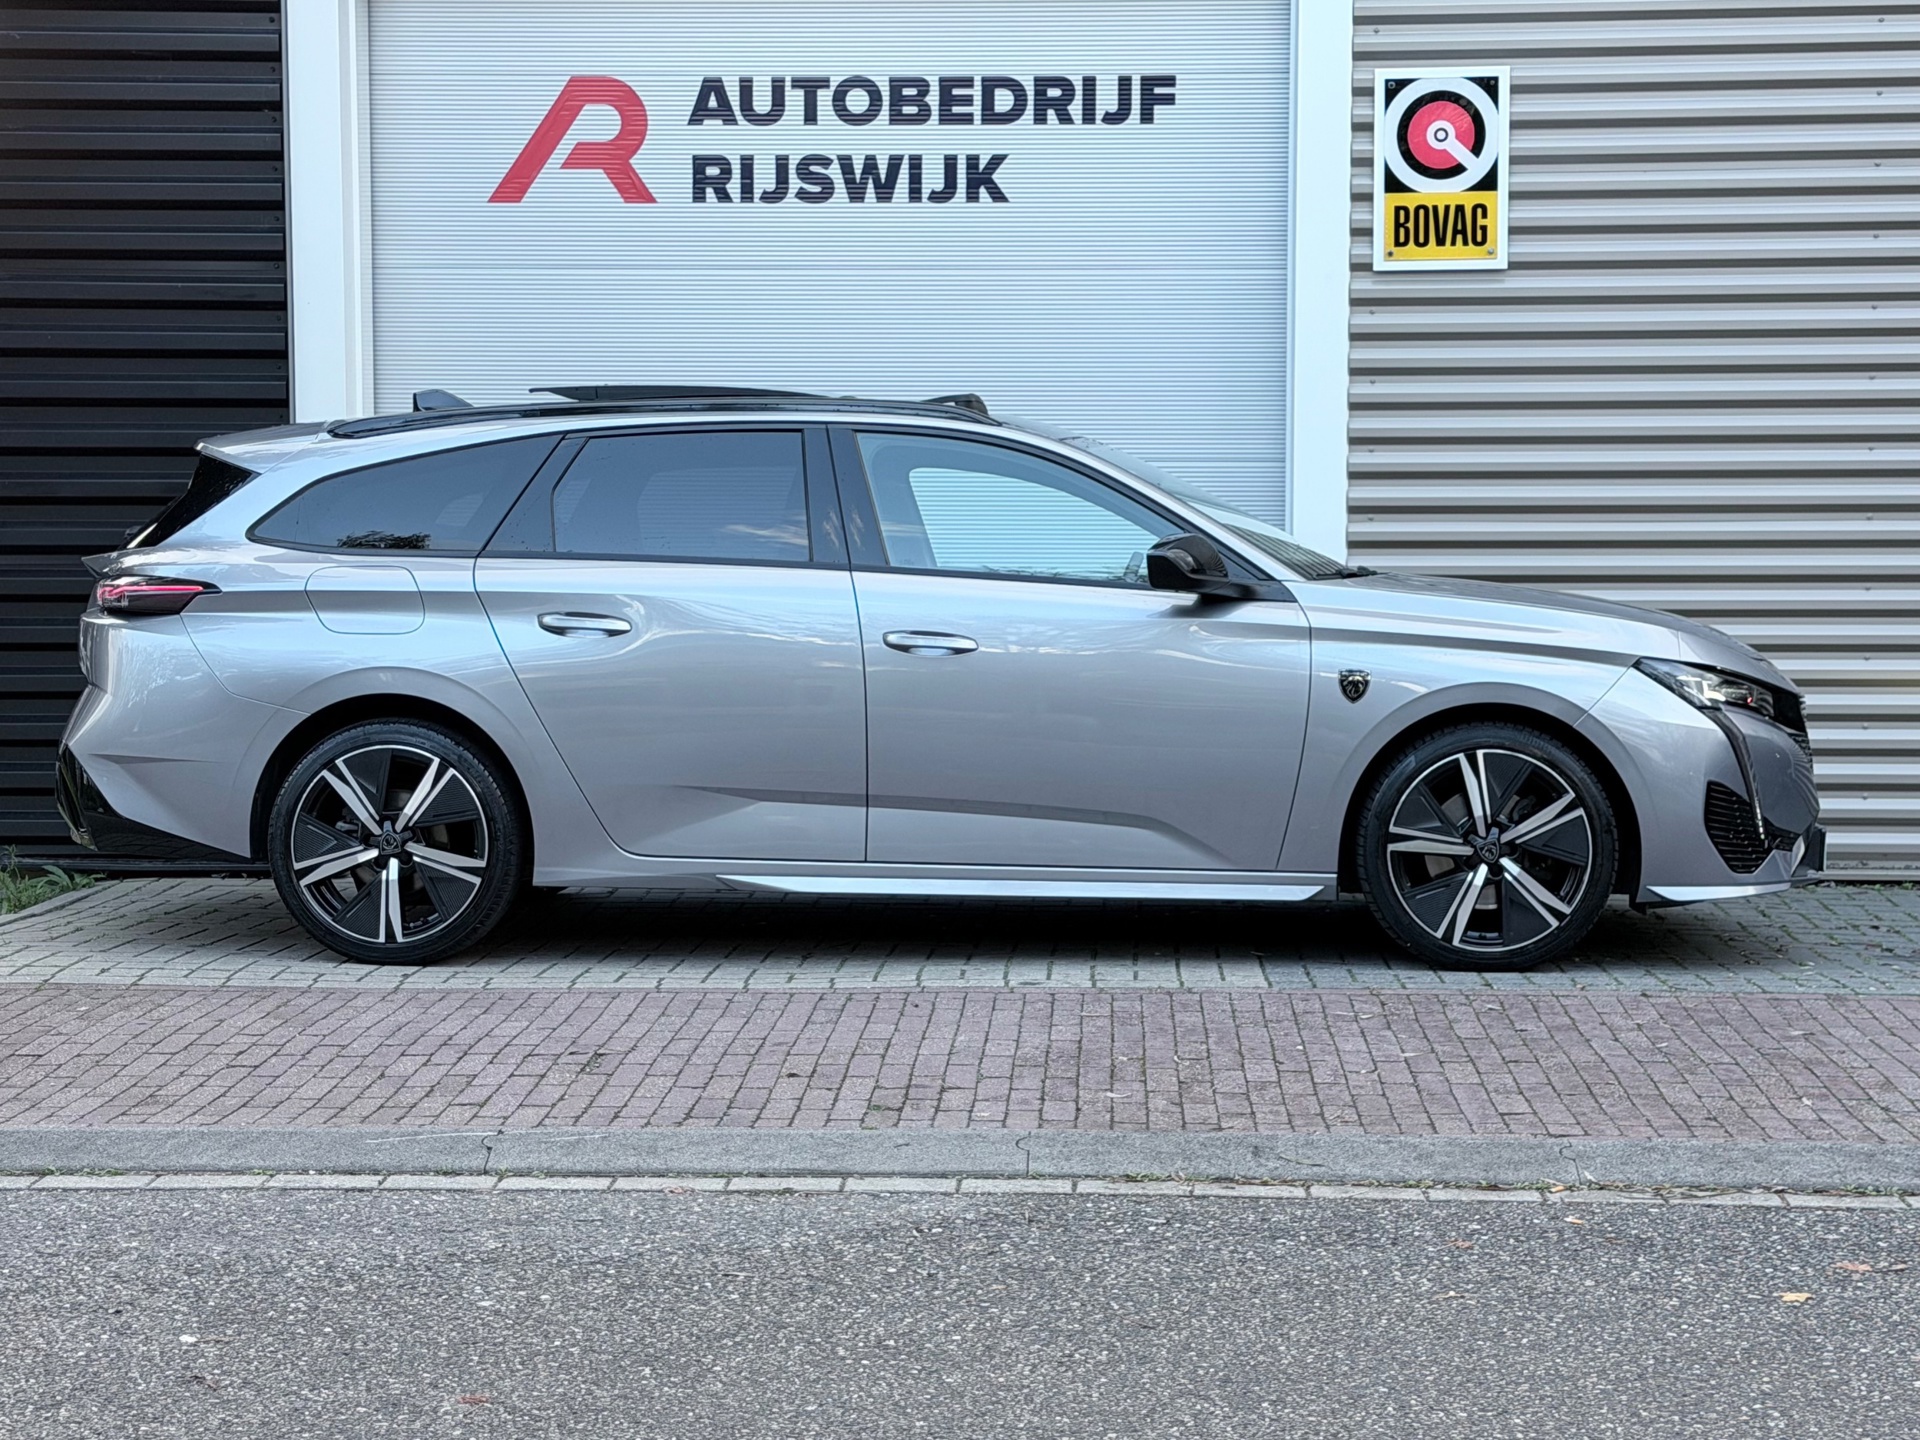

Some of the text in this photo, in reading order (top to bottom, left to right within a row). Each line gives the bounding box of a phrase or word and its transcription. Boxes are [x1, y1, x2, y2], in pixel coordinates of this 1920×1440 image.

[687, 75, 1177, 126] AUTOBEDRIJF
[692, 154, 1010, 204] RIJSWIJK
[1393, 203, 1489, 248] BOVAG
